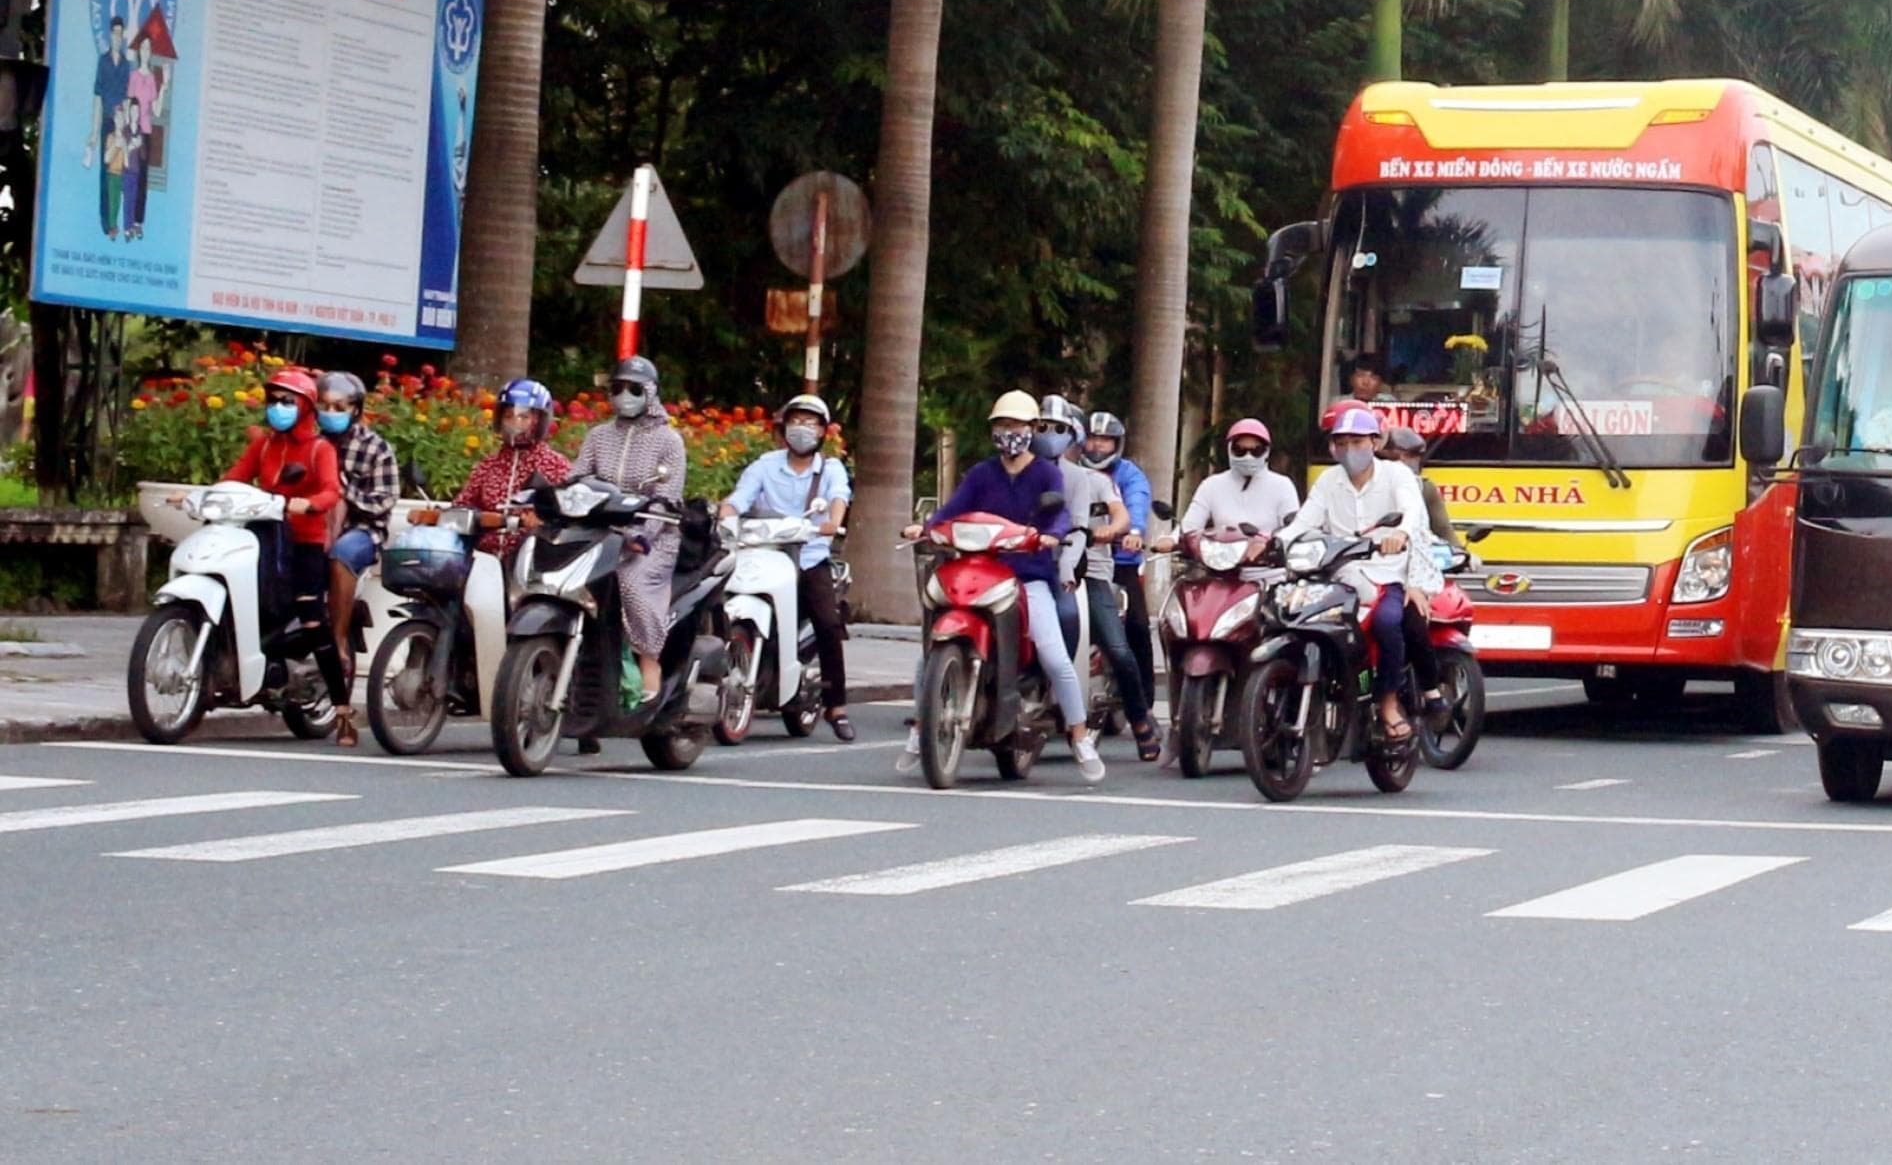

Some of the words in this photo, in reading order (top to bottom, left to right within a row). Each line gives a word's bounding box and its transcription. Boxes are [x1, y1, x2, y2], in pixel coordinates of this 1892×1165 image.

[1380, 156, 1411, 178] BẾN
[1412, 161, 1434, 178] XE
[1479, 156, 1524, 178] ĐÔNG
[1533, 156, 1565, 179] BẾN
[1567, 160, 1588, 179] XE
[1590, 156, 1634, 179] NƯỚC
[1604, 402, 1649, 434] GÒN
[1514, 479, 1585, 505] NHÃ
